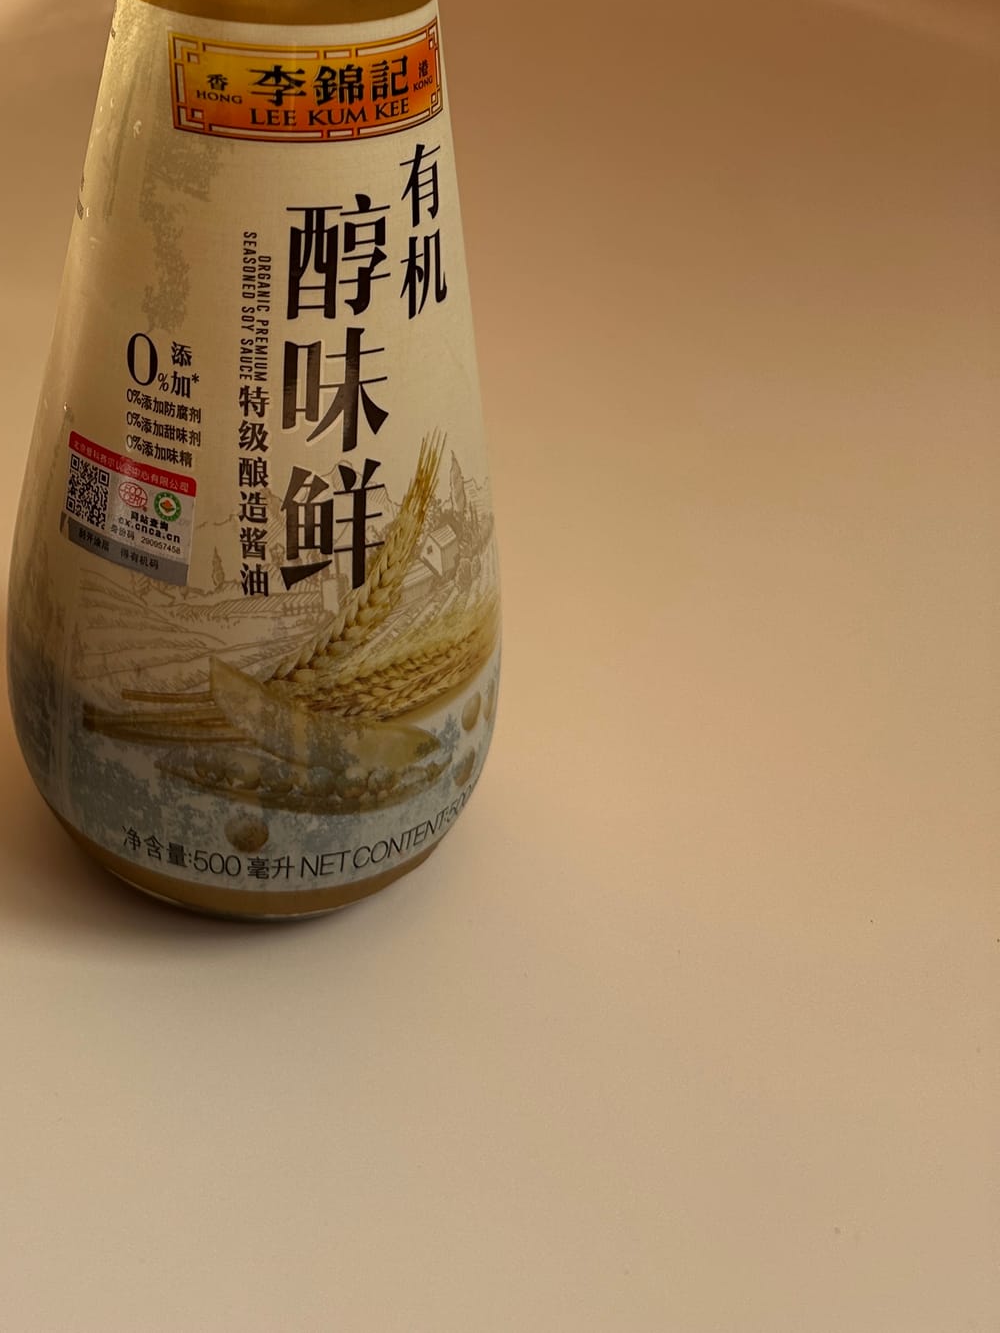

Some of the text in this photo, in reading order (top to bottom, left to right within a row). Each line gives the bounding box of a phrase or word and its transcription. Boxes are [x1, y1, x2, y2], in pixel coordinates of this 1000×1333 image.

[197, 77, 433, 105] HONG KONG
[207, 74, 228, 92] 香
[249, 55, 409, 107] 李錦記
[251, 98, 409, 126] LEE KUM KEE
[400, 144, 447, 320] 有机
[239, 231, 257, 380] SEASONED SOY SAUCE
[254, 255, 272, 382] ORGANIC PREMIUM
[126, 388, 201, 424] 0%添加防腐剂
[280, 194, 390, 590] 醇味鲜
[126, 411, 201, 447] 0%添加甜味剂
[238, 386, 270, 597] 特级酿造酱油
[300, 850, 351, 878] NET
